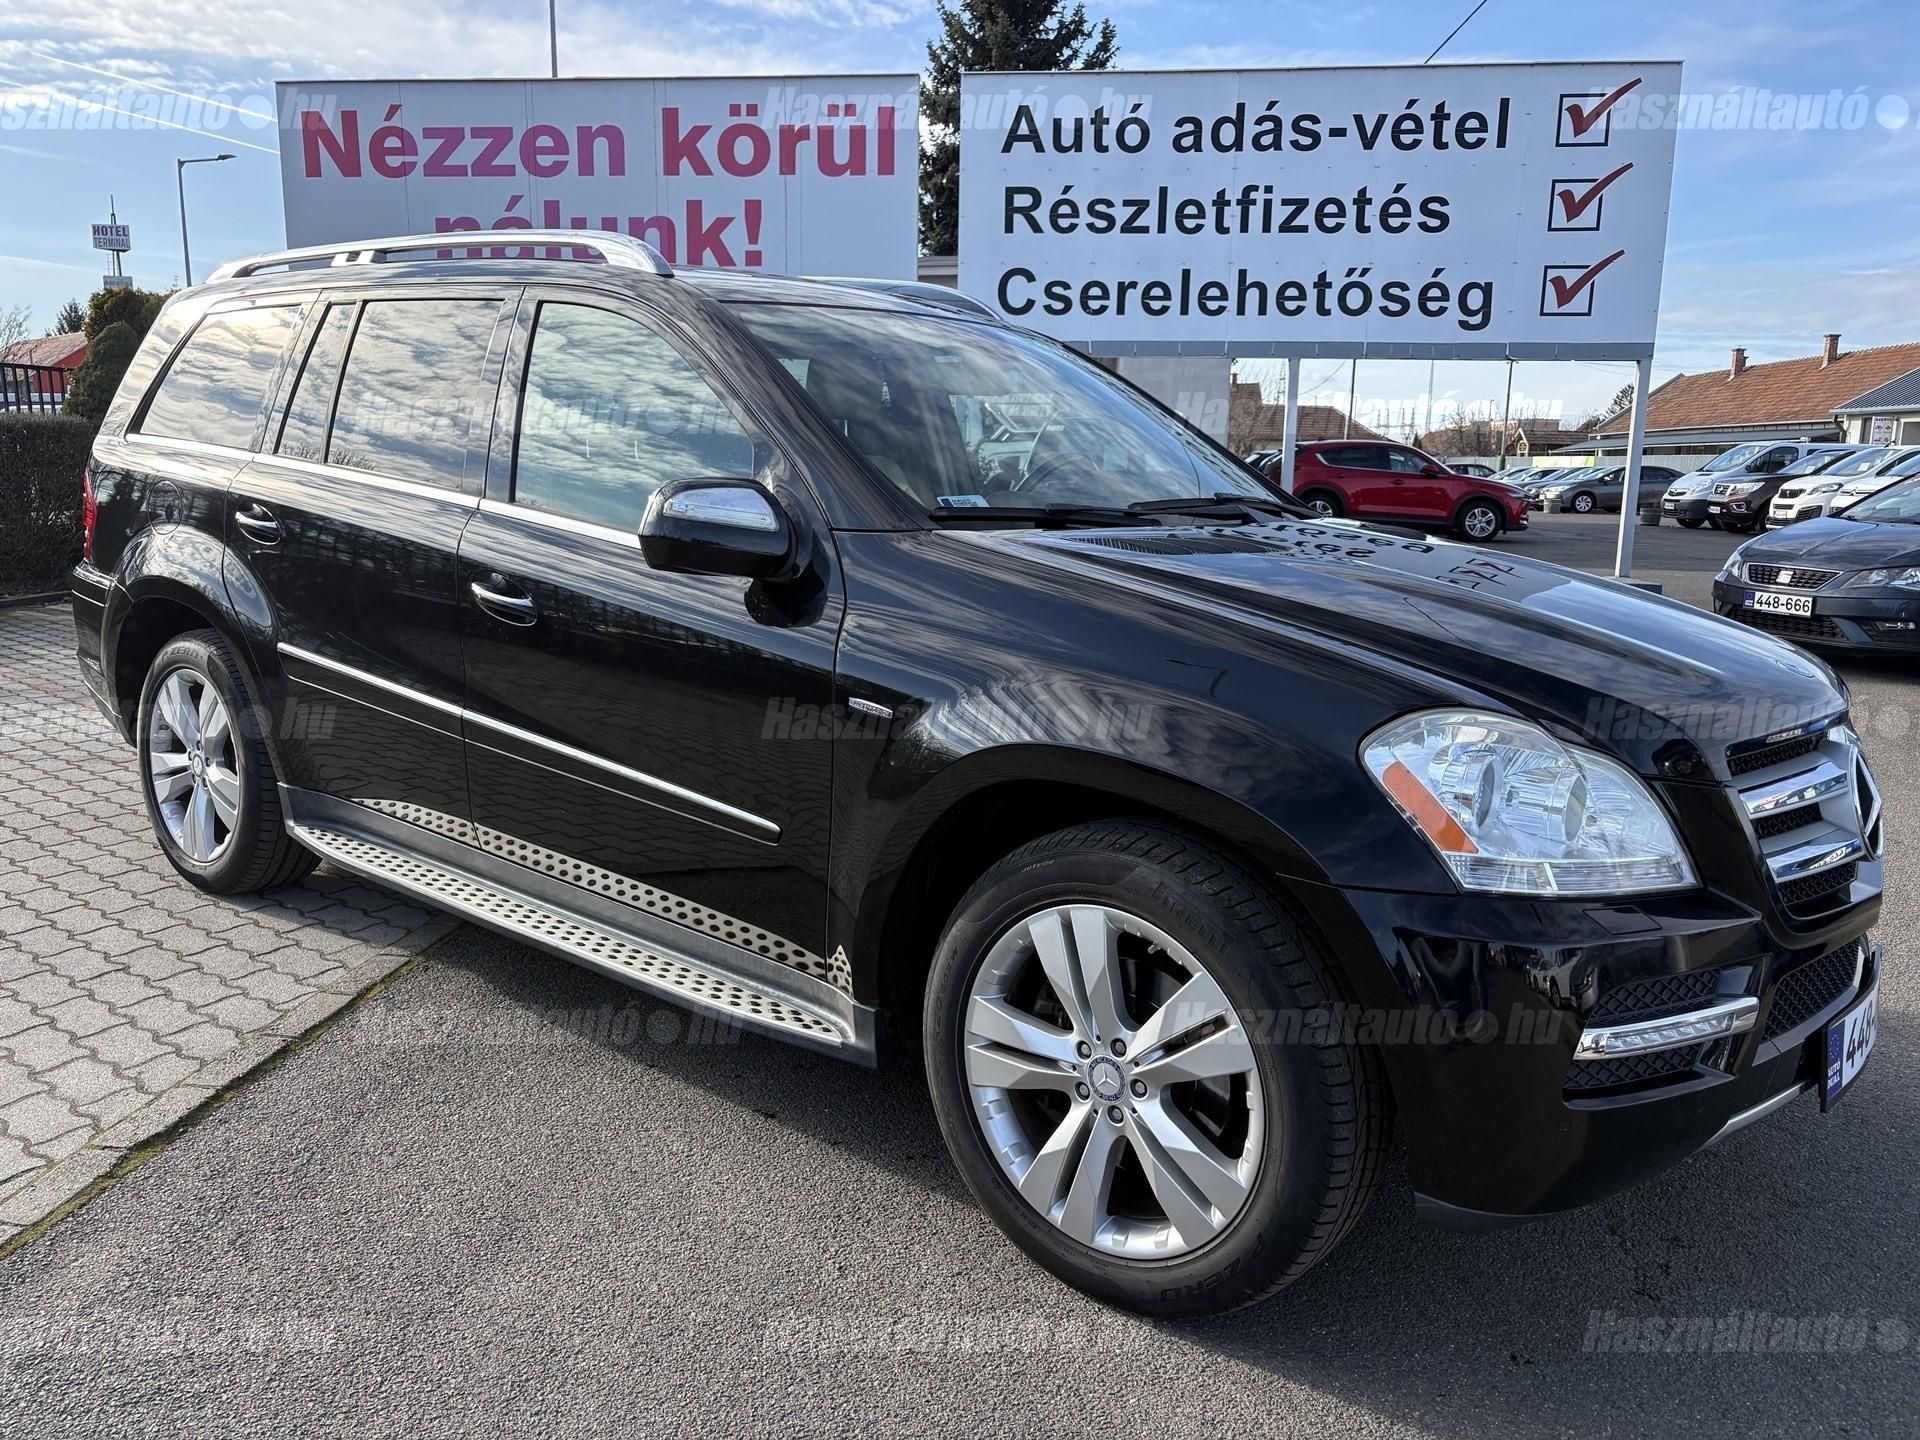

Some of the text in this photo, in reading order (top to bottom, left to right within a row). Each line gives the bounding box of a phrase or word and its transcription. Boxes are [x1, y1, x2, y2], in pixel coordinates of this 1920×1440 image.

[300, 103, 895, 179] Nézzen körül
[1000, 97, 1511, 154] Autó adás-vétel
[93, 225, 129, 237] HOTEL
[1003, 182, 1451, 235] Részletfizetés
[93, 236, 130, 249] TERMINAL
[997, 266, 1494, 331] Cserelehetőség
[1756, 594, 1811, 613] 448-666
